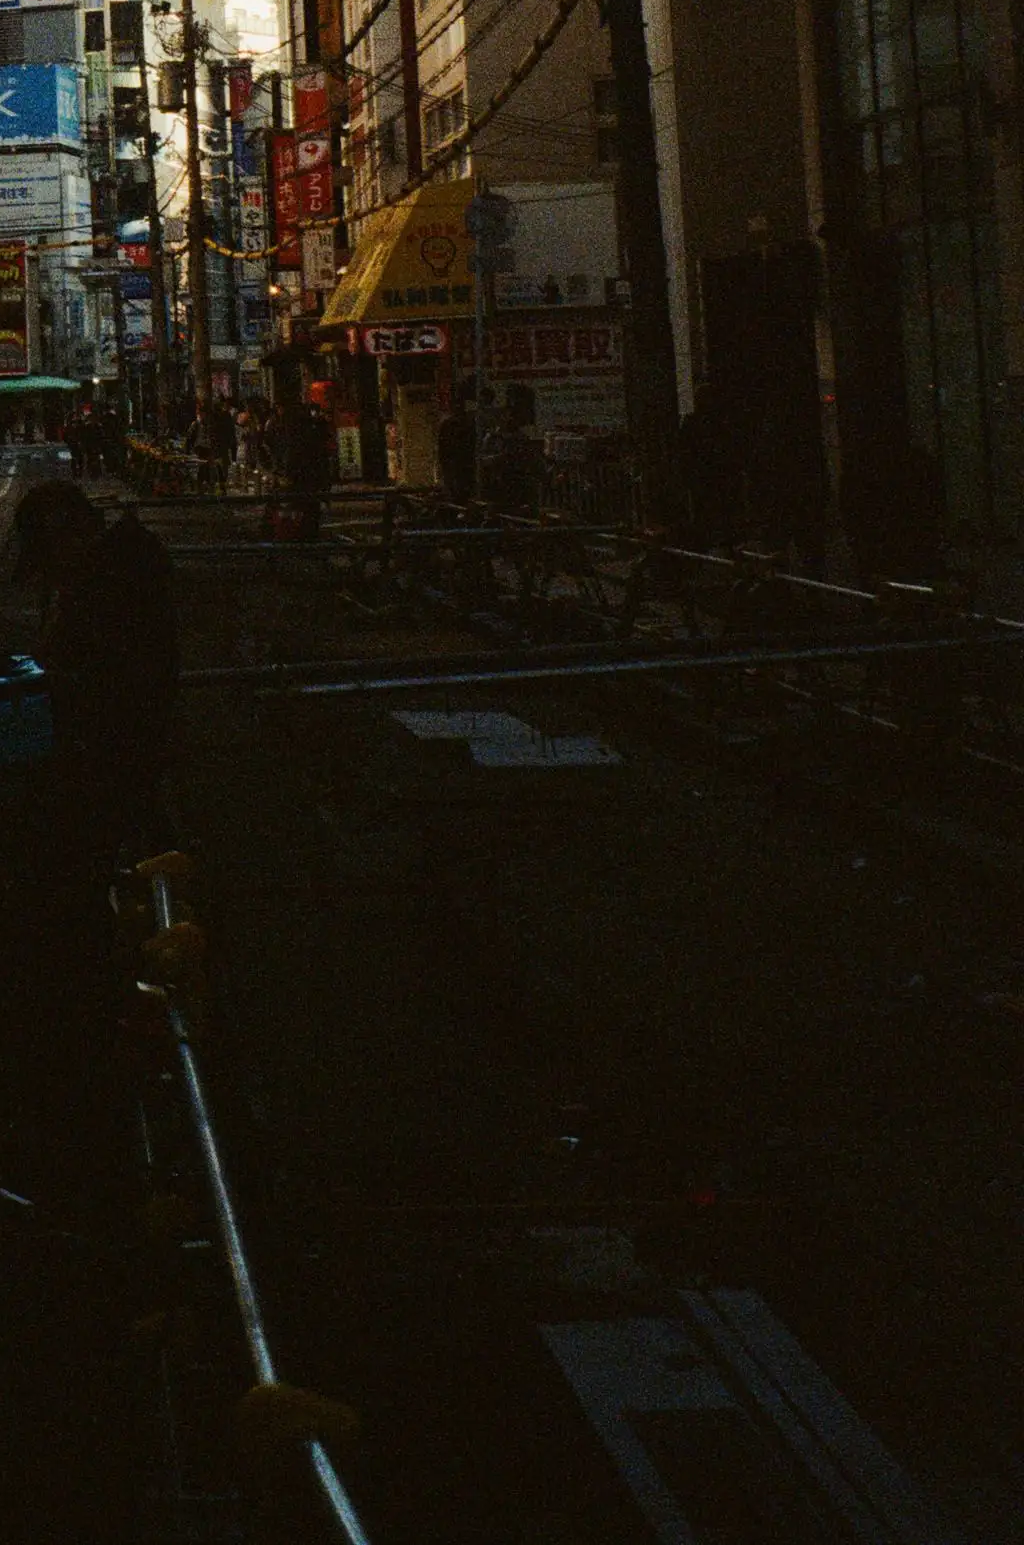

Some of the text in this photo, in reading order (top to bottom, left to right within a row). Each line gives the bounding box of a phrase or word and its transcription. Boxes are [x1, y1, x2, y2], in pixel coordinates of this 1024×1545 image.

[309, 173, 322, 212] アコム
[373, 329, 438, 352] たばこ
